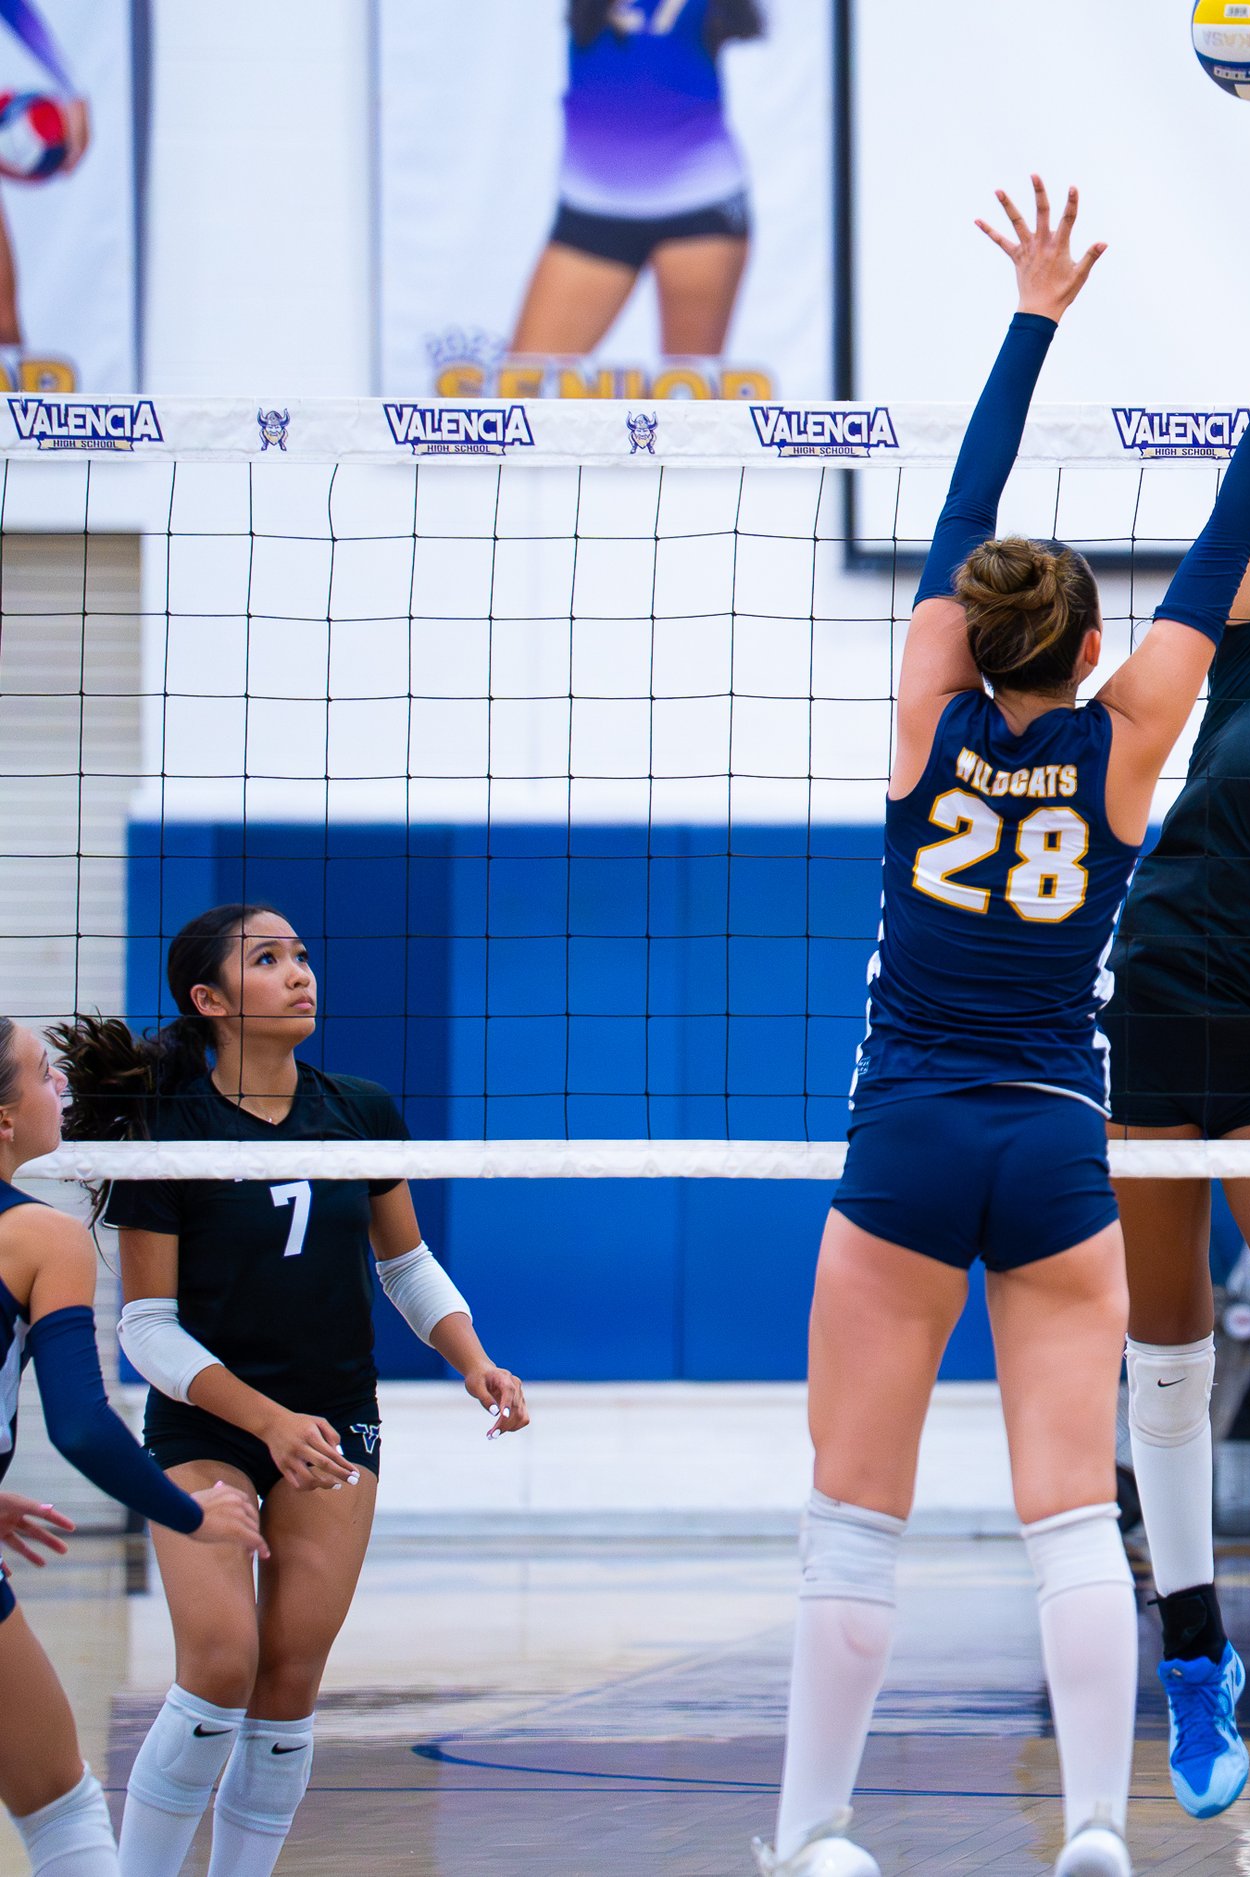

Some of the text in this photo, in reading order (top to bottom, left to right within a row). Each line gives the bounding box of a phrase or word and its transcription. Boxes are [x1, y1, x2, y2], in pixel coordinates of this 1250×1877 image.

[8, 398, 164, 442] VALENCIA
[383, 403, 535, 446] VALENCIA
[749, 406, 899, 448] VALENCIA
[53, 440, 117, 449] HIGH SCHOOL
[427, 444, 491, 453] HIGH SCHOOL
[793, 446, 856, 455] HIGH SCHOOL
[1155, 448, 1216, 456] HIGH SCHOOL
[955, 746, 1078, 798] WILDCATS
[912, 786, 1089, 924] 28
[269, 1180, 312, 1257] 7
